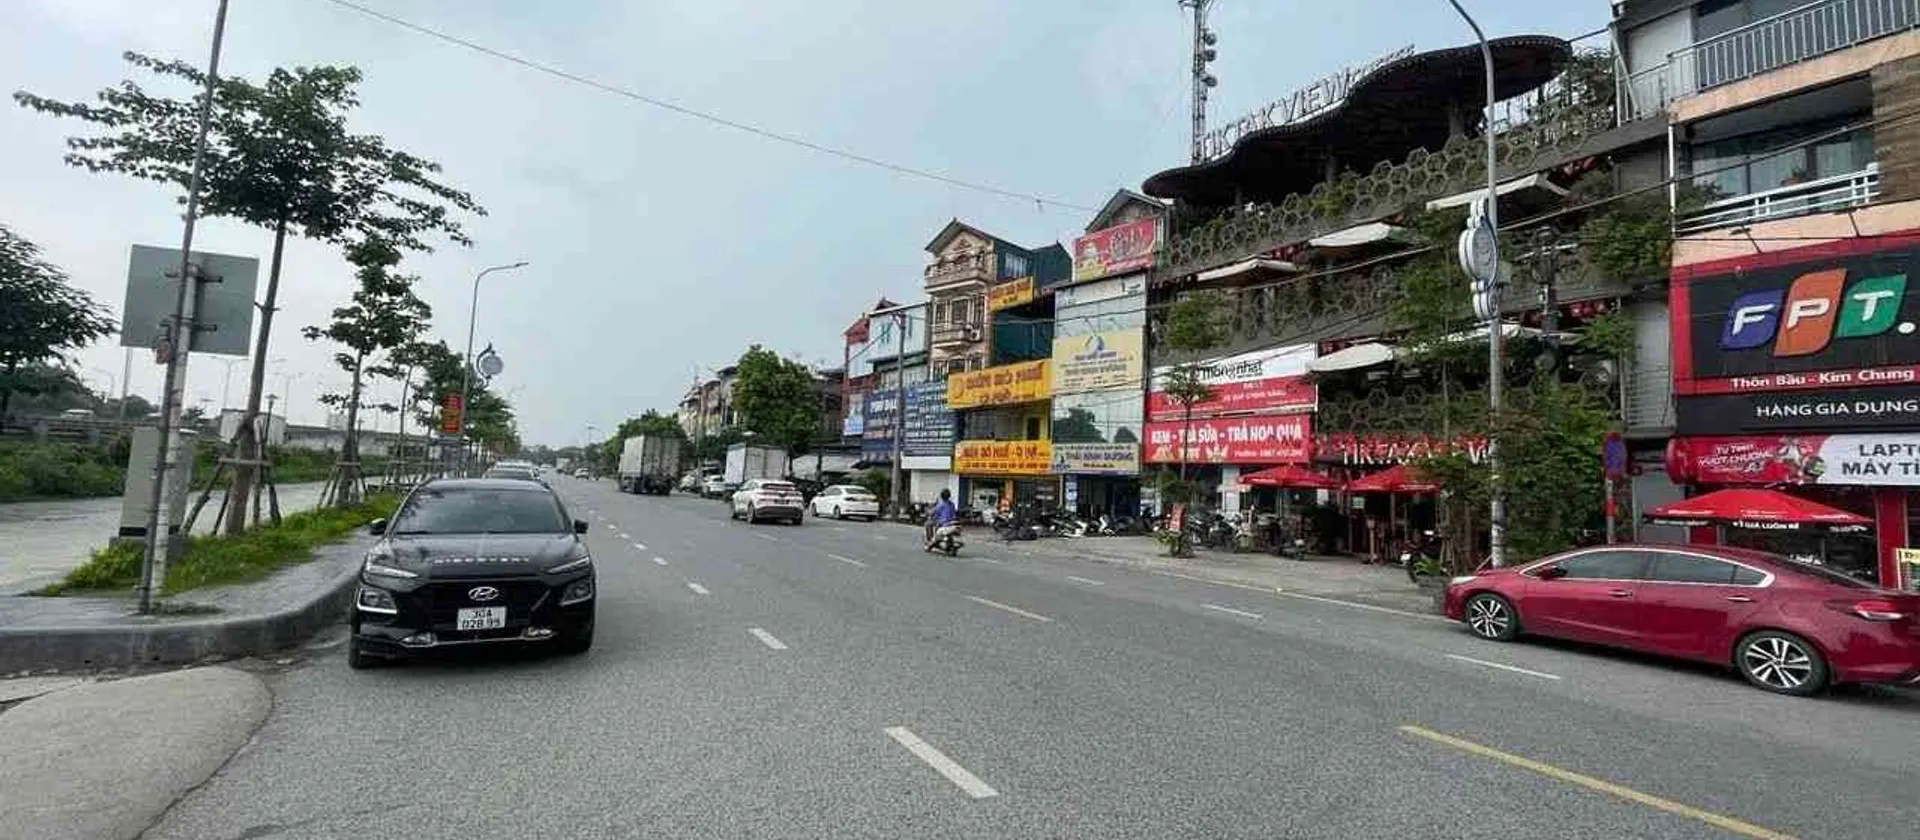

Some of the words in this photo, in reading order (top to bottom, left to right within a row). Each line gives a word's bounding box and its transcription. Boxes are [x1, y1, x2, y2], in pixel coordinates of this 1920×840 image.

[1818, 371, 1851, 384] Kim
[1858, 368, 1915, 383] Chung
[1816, 402, 1850, 415] GIA
[1855, 400, 1919, 417] DỤNG
[1859, 443, 1920, 457] LAPT
[1842, 458, 1892, 475] MÁY
